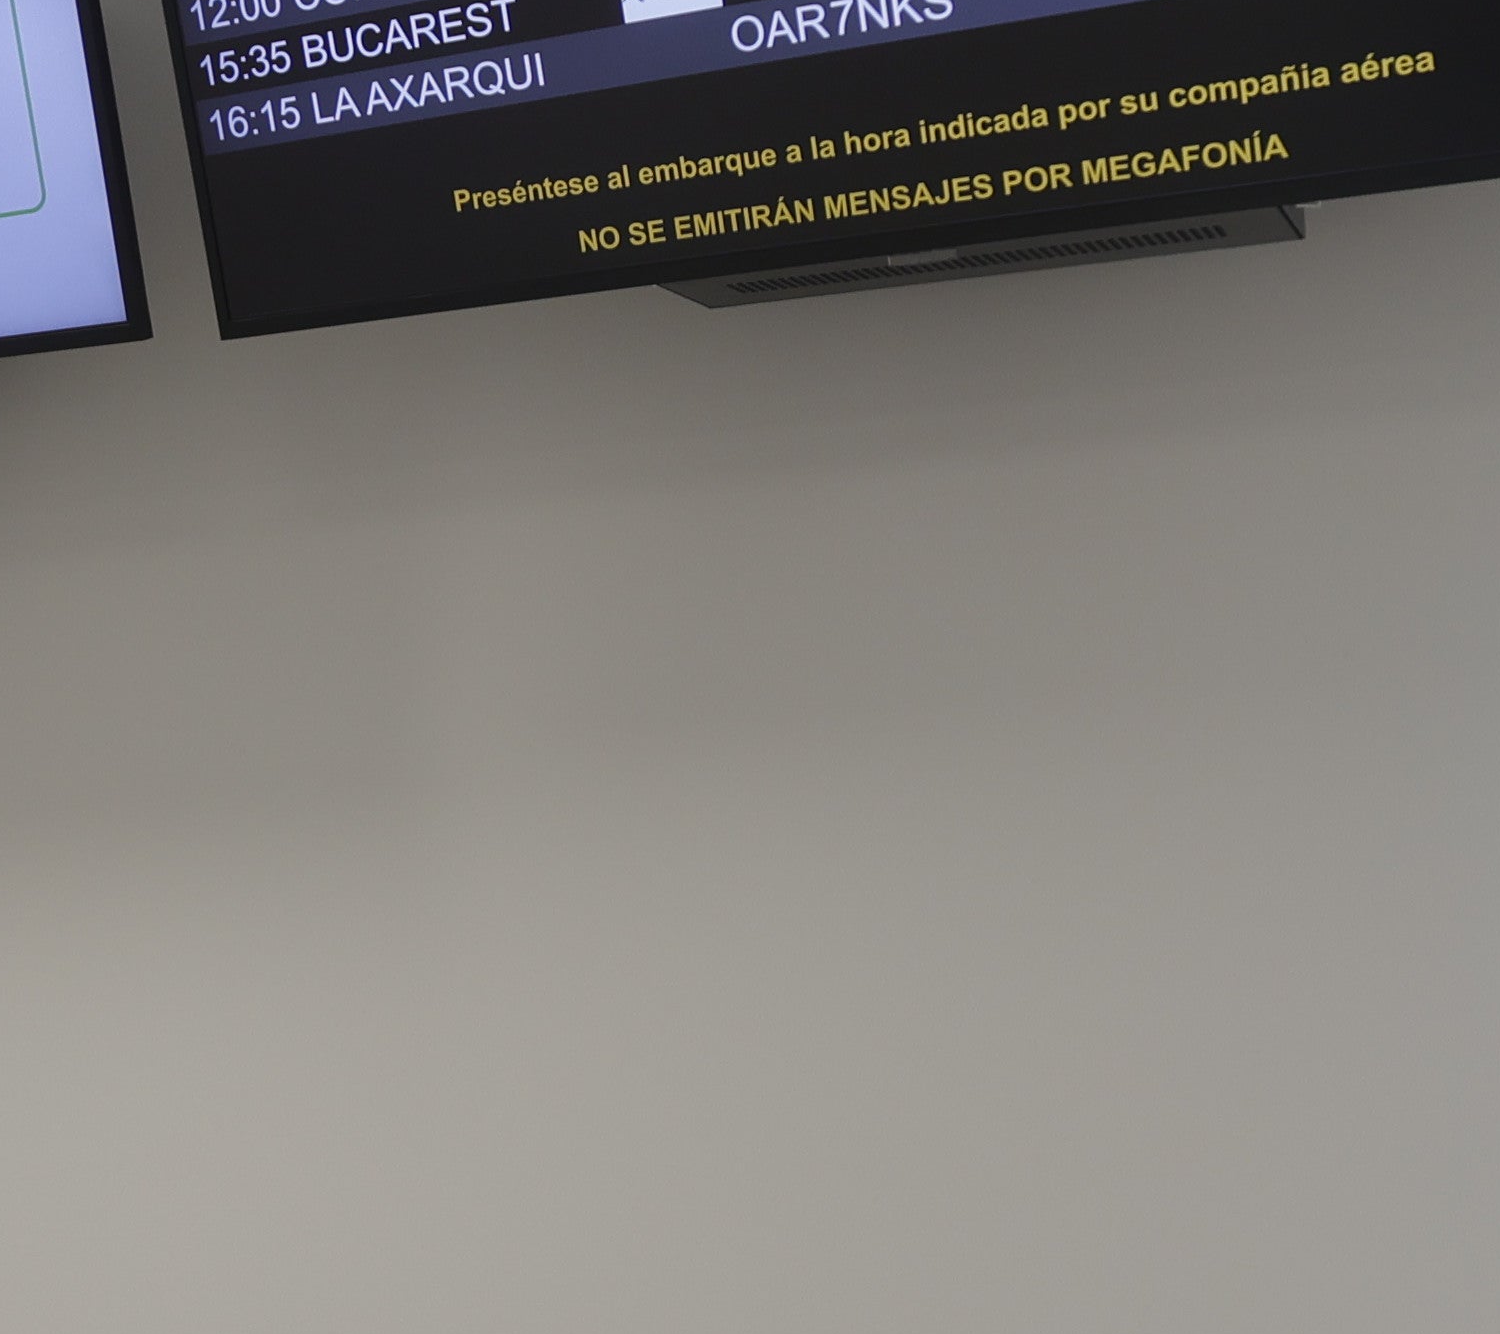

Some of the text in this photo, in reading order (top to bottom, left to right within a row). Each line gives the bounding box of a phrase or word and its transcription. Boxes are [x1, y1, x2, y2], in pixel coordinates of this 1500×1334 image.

[200, 39, 292, 86] 15:35
[209, 95, 301, 141] 16:15
[453, 51, 1435, 213] Preséntese al embarque a la hora indicada por su compañia aérea
[578, 129, 1289, 253] NO SE EMITIRÁN MENSAJES POR MEGAFONÍA
